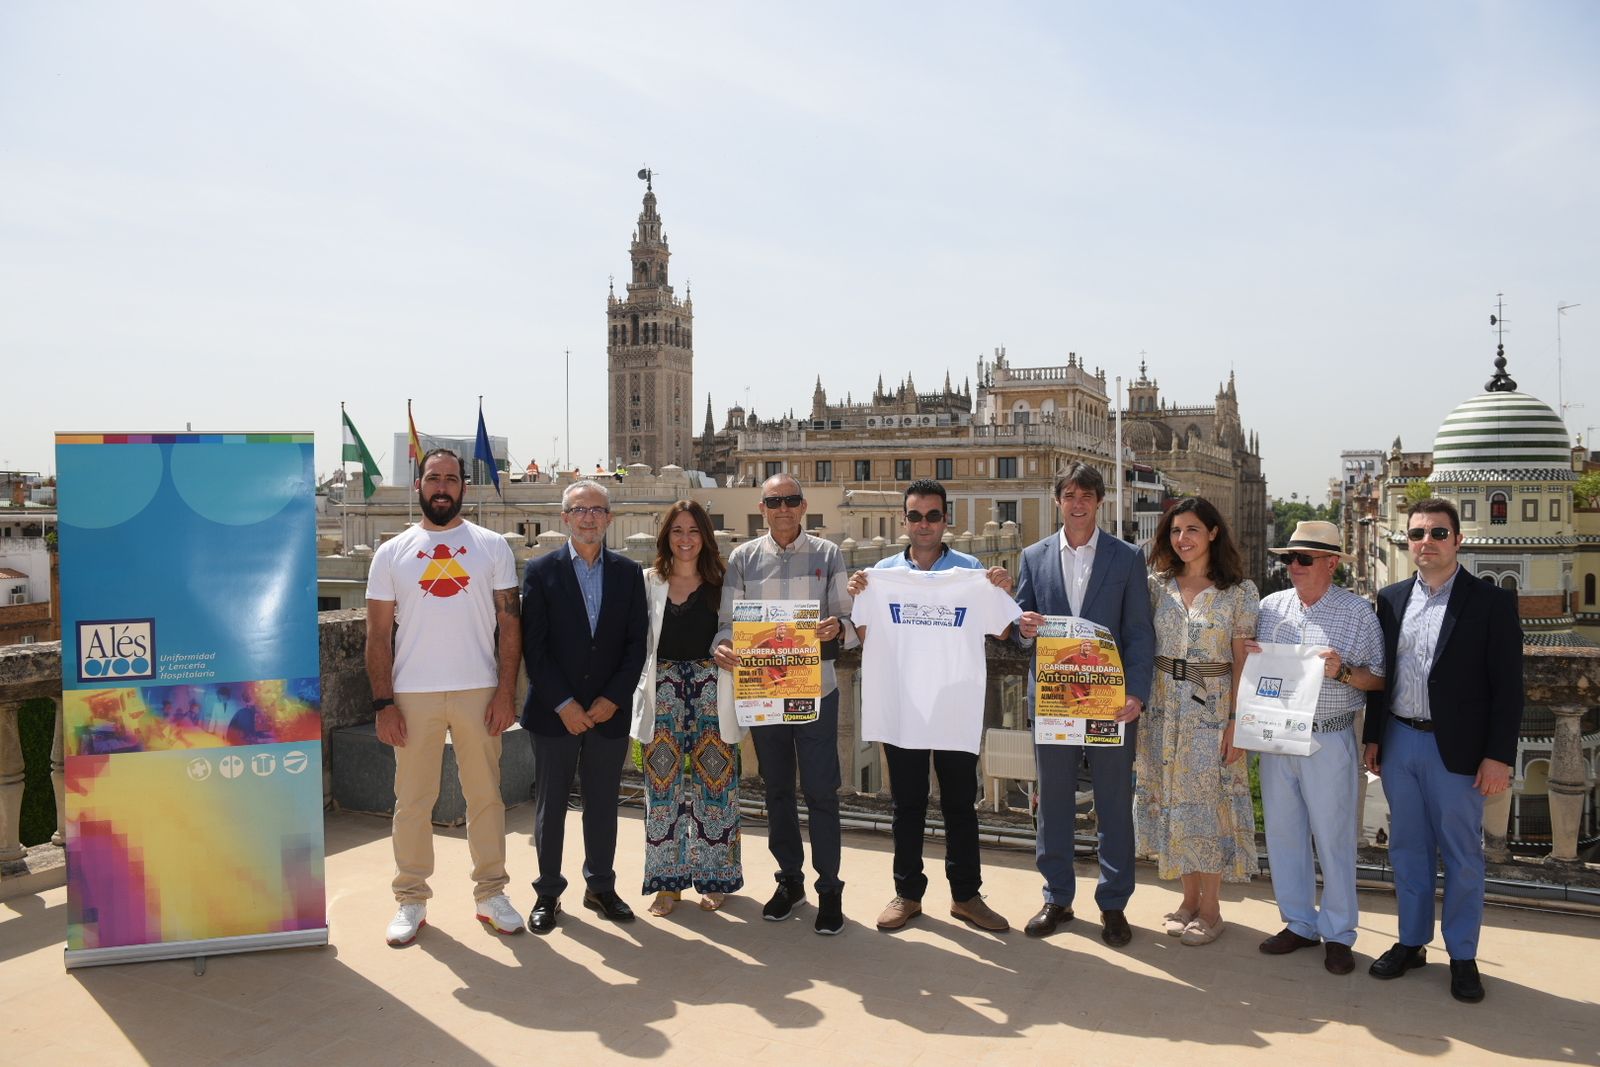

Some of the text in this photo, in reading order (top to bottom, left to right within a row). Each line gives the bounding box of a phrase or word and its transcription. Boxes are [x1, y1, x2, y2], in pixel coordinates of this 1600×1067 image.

[86, 626, 146, 658] Alés
[777, 647, 818, 655] SOLIDARIA
[160, 652, 216, 662] Uniformidad
[739, 655, 819, 667] Antonio Rivas
[1043, 663, 1080, 671] CARRERA
[1081, 665, 1121, 673] SOLIDARIA
[160, 671, 215, 680] Hospitalaria
[1038, 671, 1123, 684] Antonio Rivas
